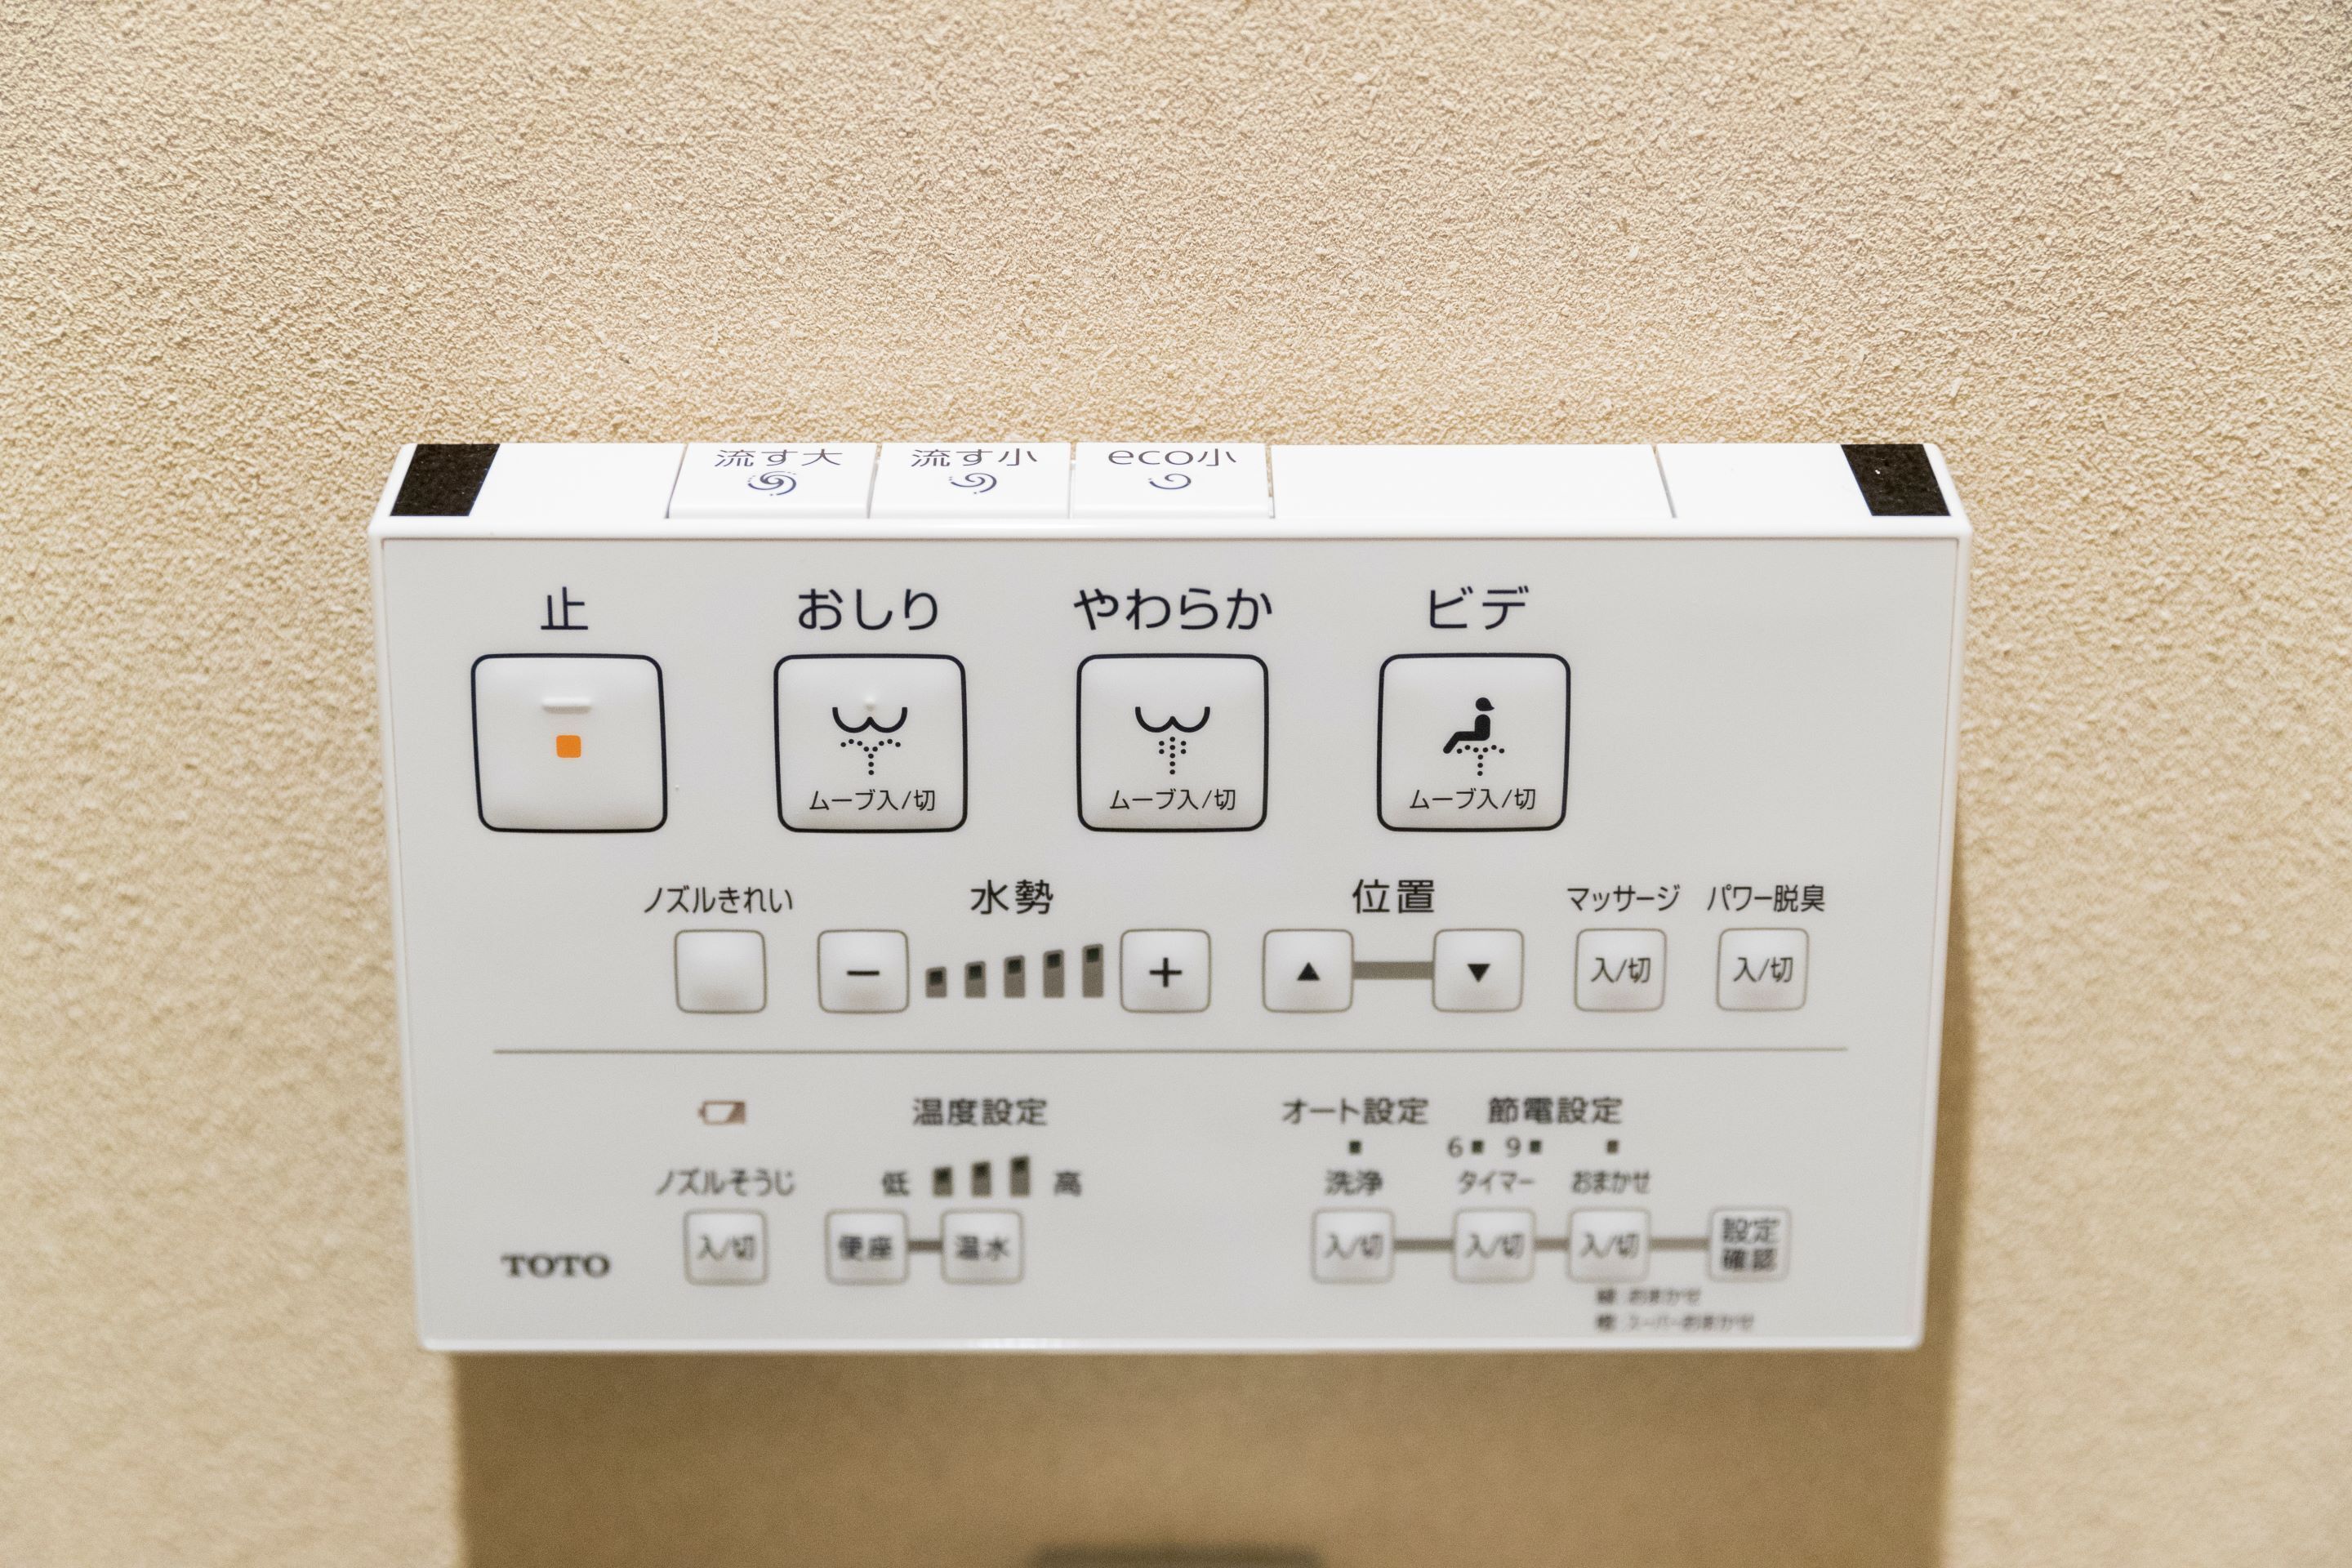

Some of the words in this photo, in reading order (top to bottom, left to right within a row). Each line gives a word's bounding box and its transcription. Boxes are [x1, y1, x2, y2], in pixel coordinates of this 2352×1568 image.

[715, 448, 841, 467] 流す大
[911, 448, 1037, 467] 流す小
[1107, 448, 1236, 467] eco小
[540, 586, 589, 631] 止
[798, 588, 938, 631] おしり
[1073, 587, 1273, 631] やわらか
[1429, 585, 1530, 630] ビデ
[808, 788, 936, 812] ムーブ入/切
[1109, 788, 1236, 812] ムーブ入/切
[1409, 787, 1536, 811] ムーブ入/切
[644, 884, 793, 915] ノズルきれい
[970, 879, 1054, 915] 水勢
[1352, 878, 1435, 915] 位置
[1566, 884, 1681, 913] マッサージ
[1707, 884, 1825, 913] パワー脱臭
[1590, 956, 1651, 984] 入/切
[1732, 956, 1794, 984] 入/切
[913, 1097, 1048, 1127] 温度設定
[1282, 1096, 1429, 1125] オート設定
[1487, 1096, 1623, 1125] 節電設定
[1446, 1136, 1464, 1158] 6
[1504, 1135, 1522, 1158] 9
[656, 1167, 795, 1197] ノズルそうじ
[880, 1170, 911, 1197] 低
[1054, 1169, 1082, 1197] 高
[1325, 1169, 1384, 1196] 洗浄
[1458, 1169, 1535, 1195] タイマー
[1570, 1169, 1650, 1195] おまかせ
[1721, 1217, 1780, 1245] 設定
[838, 1235, 893, 1262] 便座
[956, 1235, 1009, 1262] 温水
[1722, 1247, 1775, 1272] 確認
[501, 1254, 612, 1278] TOTO
